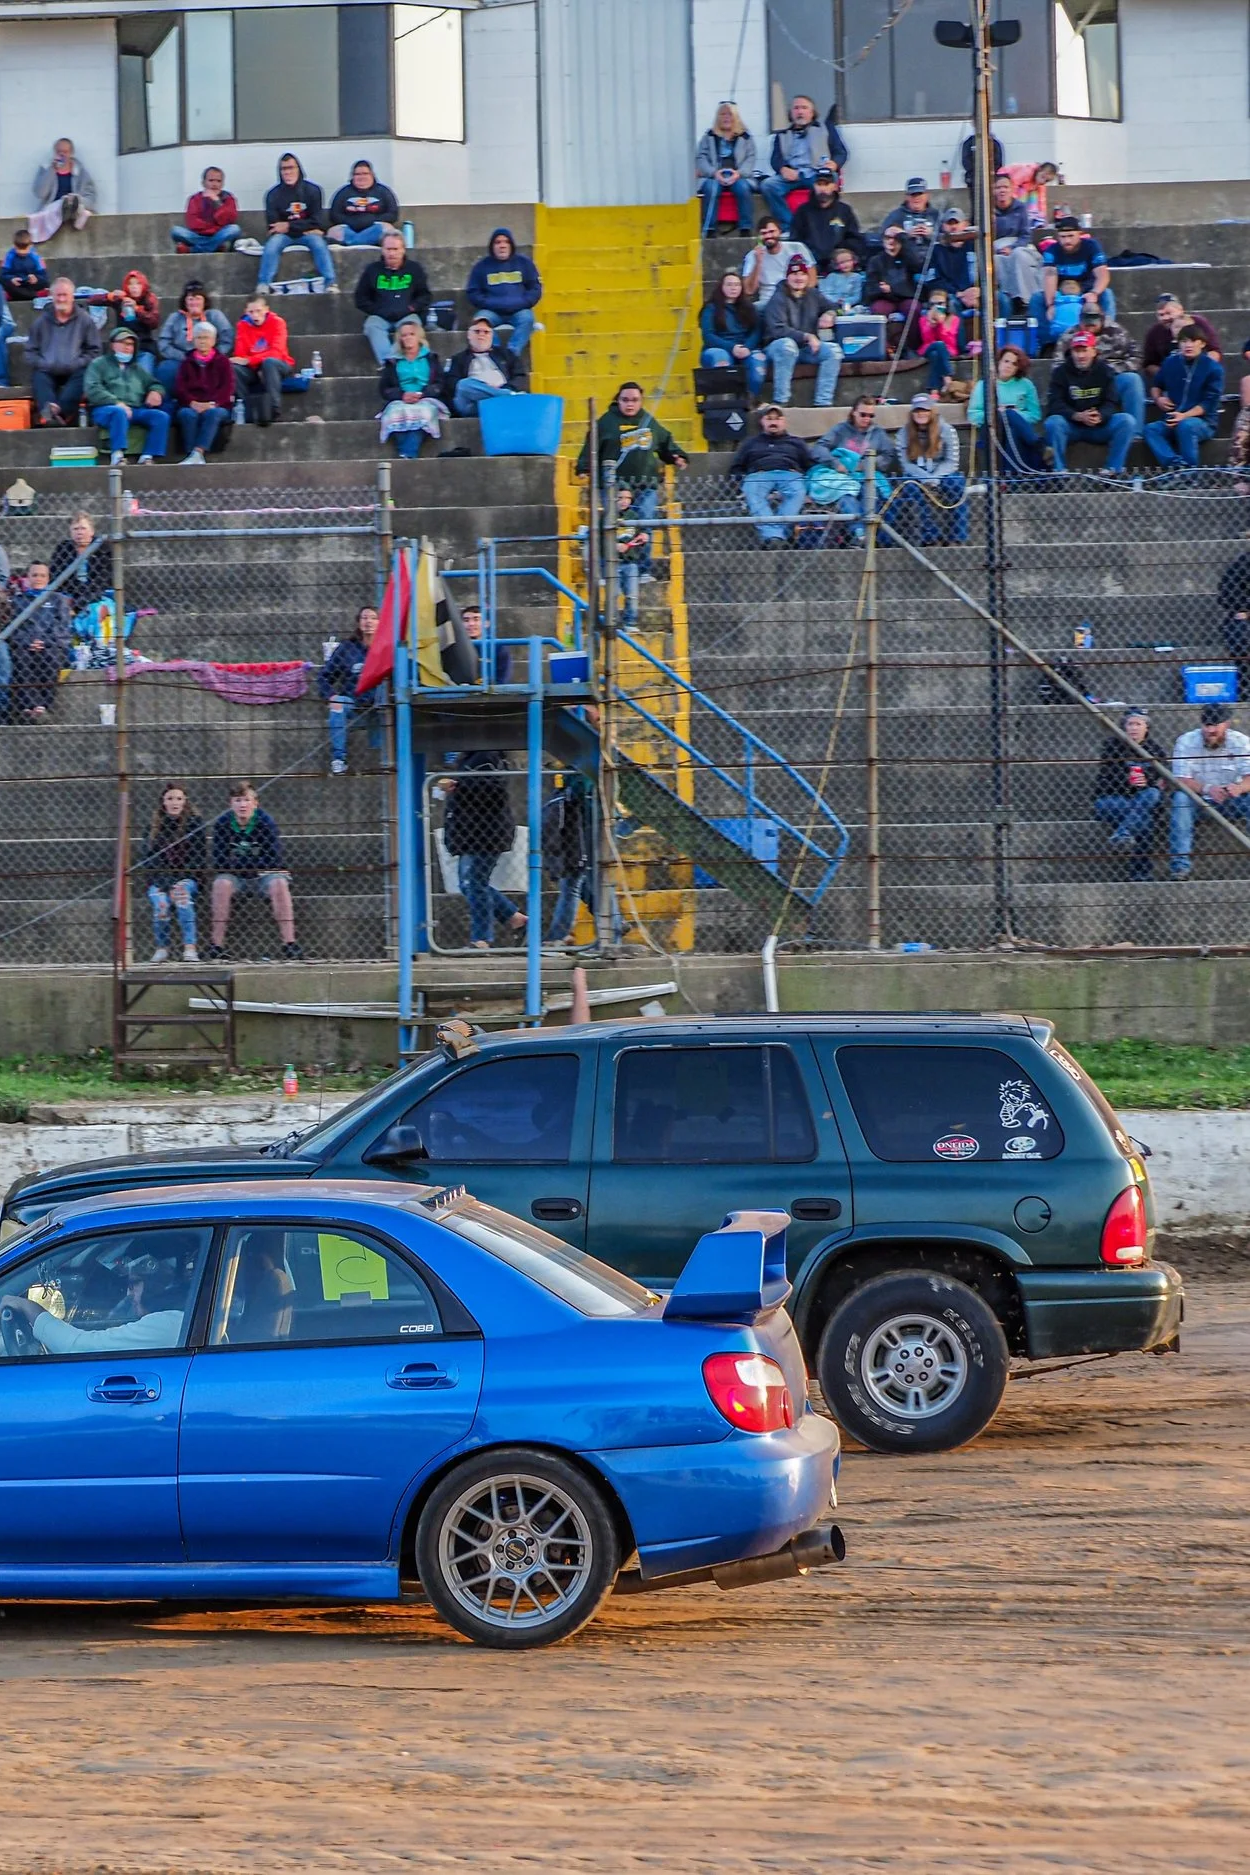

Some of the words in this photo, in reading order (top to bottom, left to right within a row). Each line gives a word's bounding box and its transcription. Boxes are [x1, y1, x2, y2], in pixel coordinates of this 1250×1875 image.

[400, 1324, 434, 1333] COBB
[943, 1308, 984, 1368] KELLY
[847, 1384, 917, 1435] SAFARI
